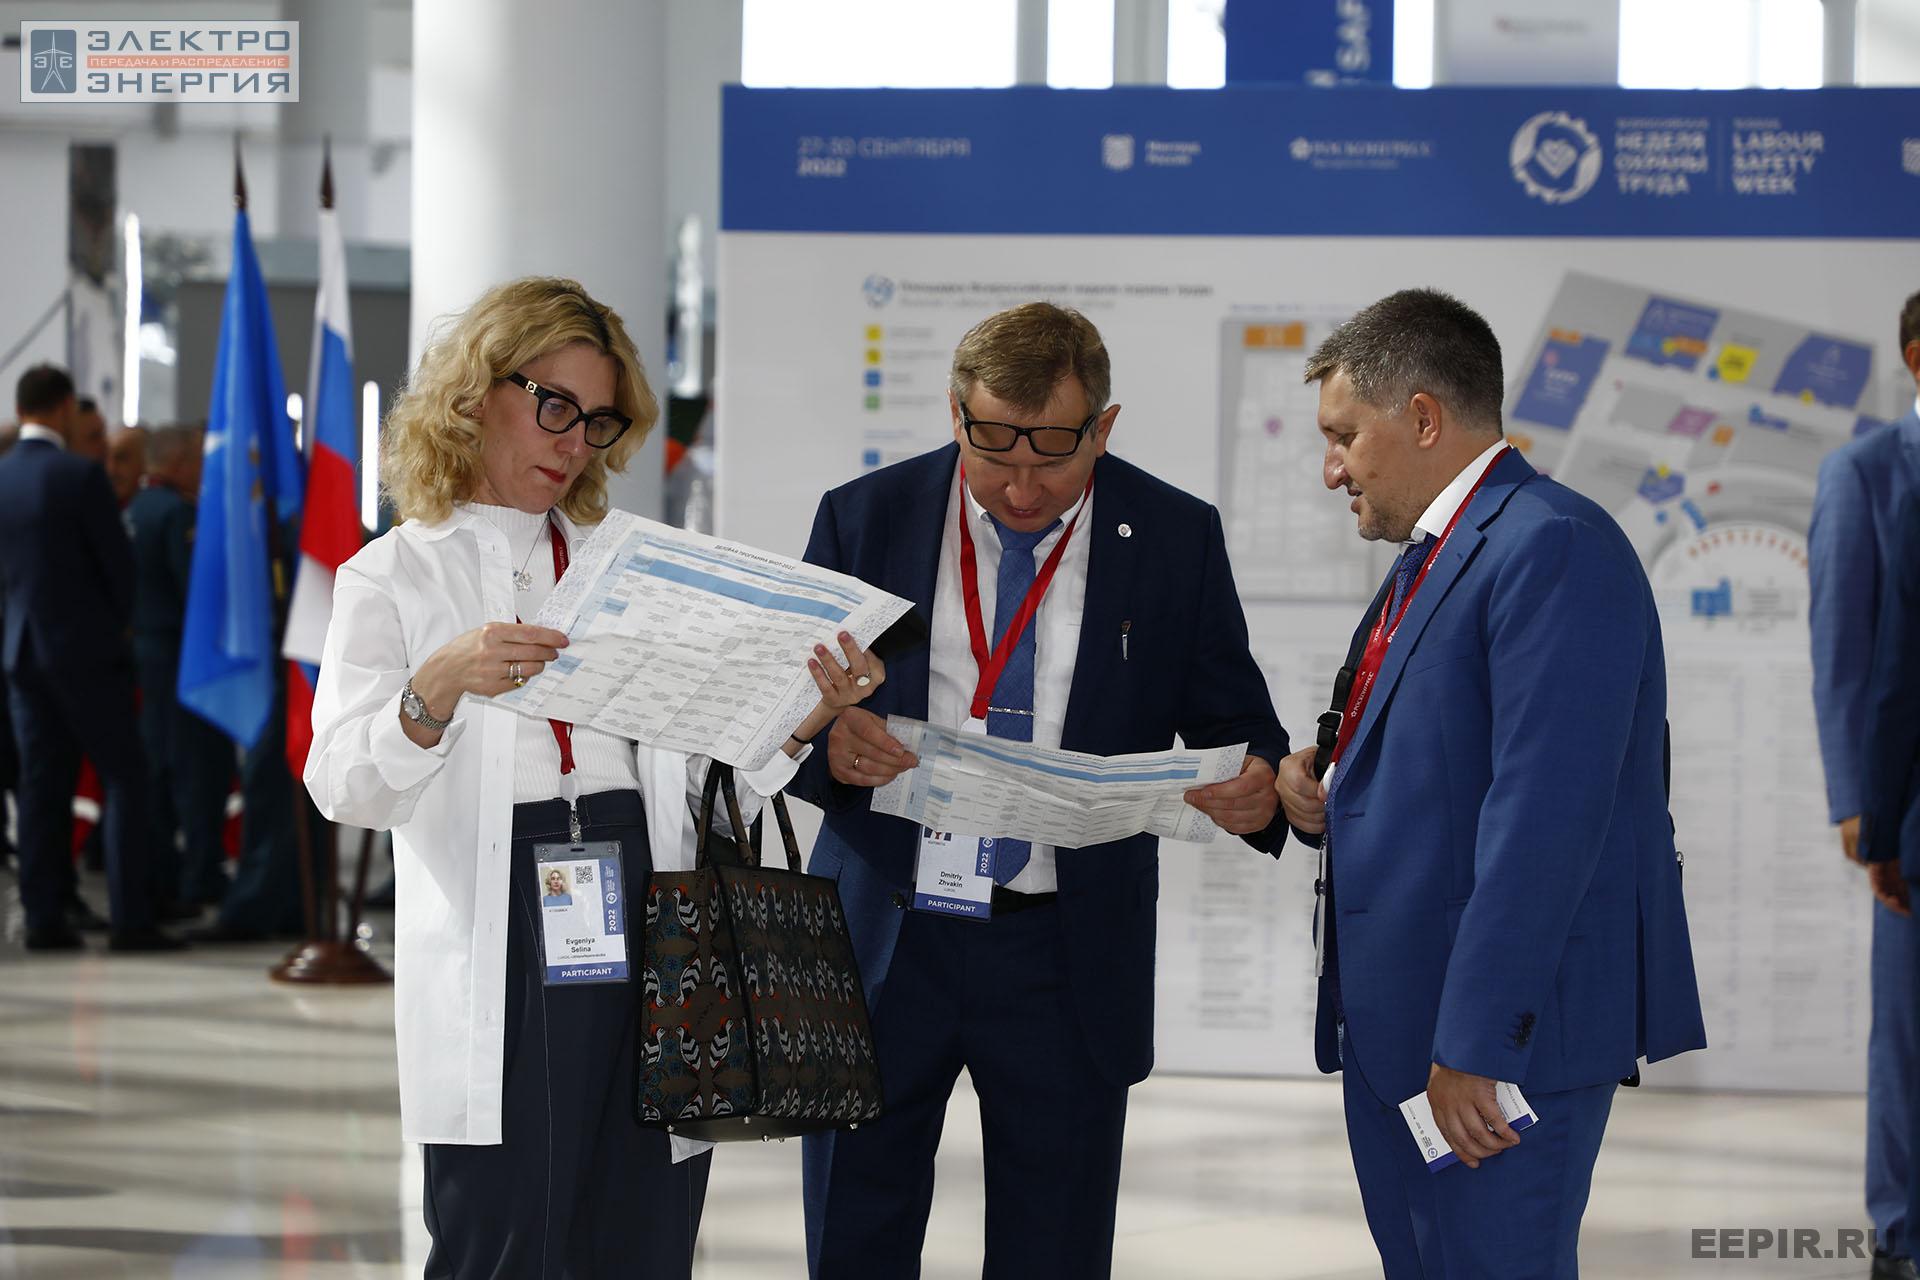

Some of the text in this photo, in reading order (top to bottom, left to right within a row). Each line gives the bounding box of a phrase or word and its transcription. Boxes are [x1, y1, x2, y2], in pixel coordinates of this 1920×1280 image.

[1615, 131, 1706, 150] НЕДЕЛЯ
[1733, 131, 1824, 151] LABOUR
[1614, 153, 1708, 173] ОХРАНЫ
[1733, 153, 1815, 173] SAFETY
[1618, 174, 1689, 195] ТРУДА
[1733, 175, 1796, 194] WEEK
[981, 852, 989, 873] 2022
[940, 871, 962, 880] Dmitriy
[928, 900, 976, 912] PARTICIPANT
[608, 909, 617, 931] 2022
[566, 937, 595, 945] Evgeniya
[562, 968, 612, 977] PARTICIPANT
